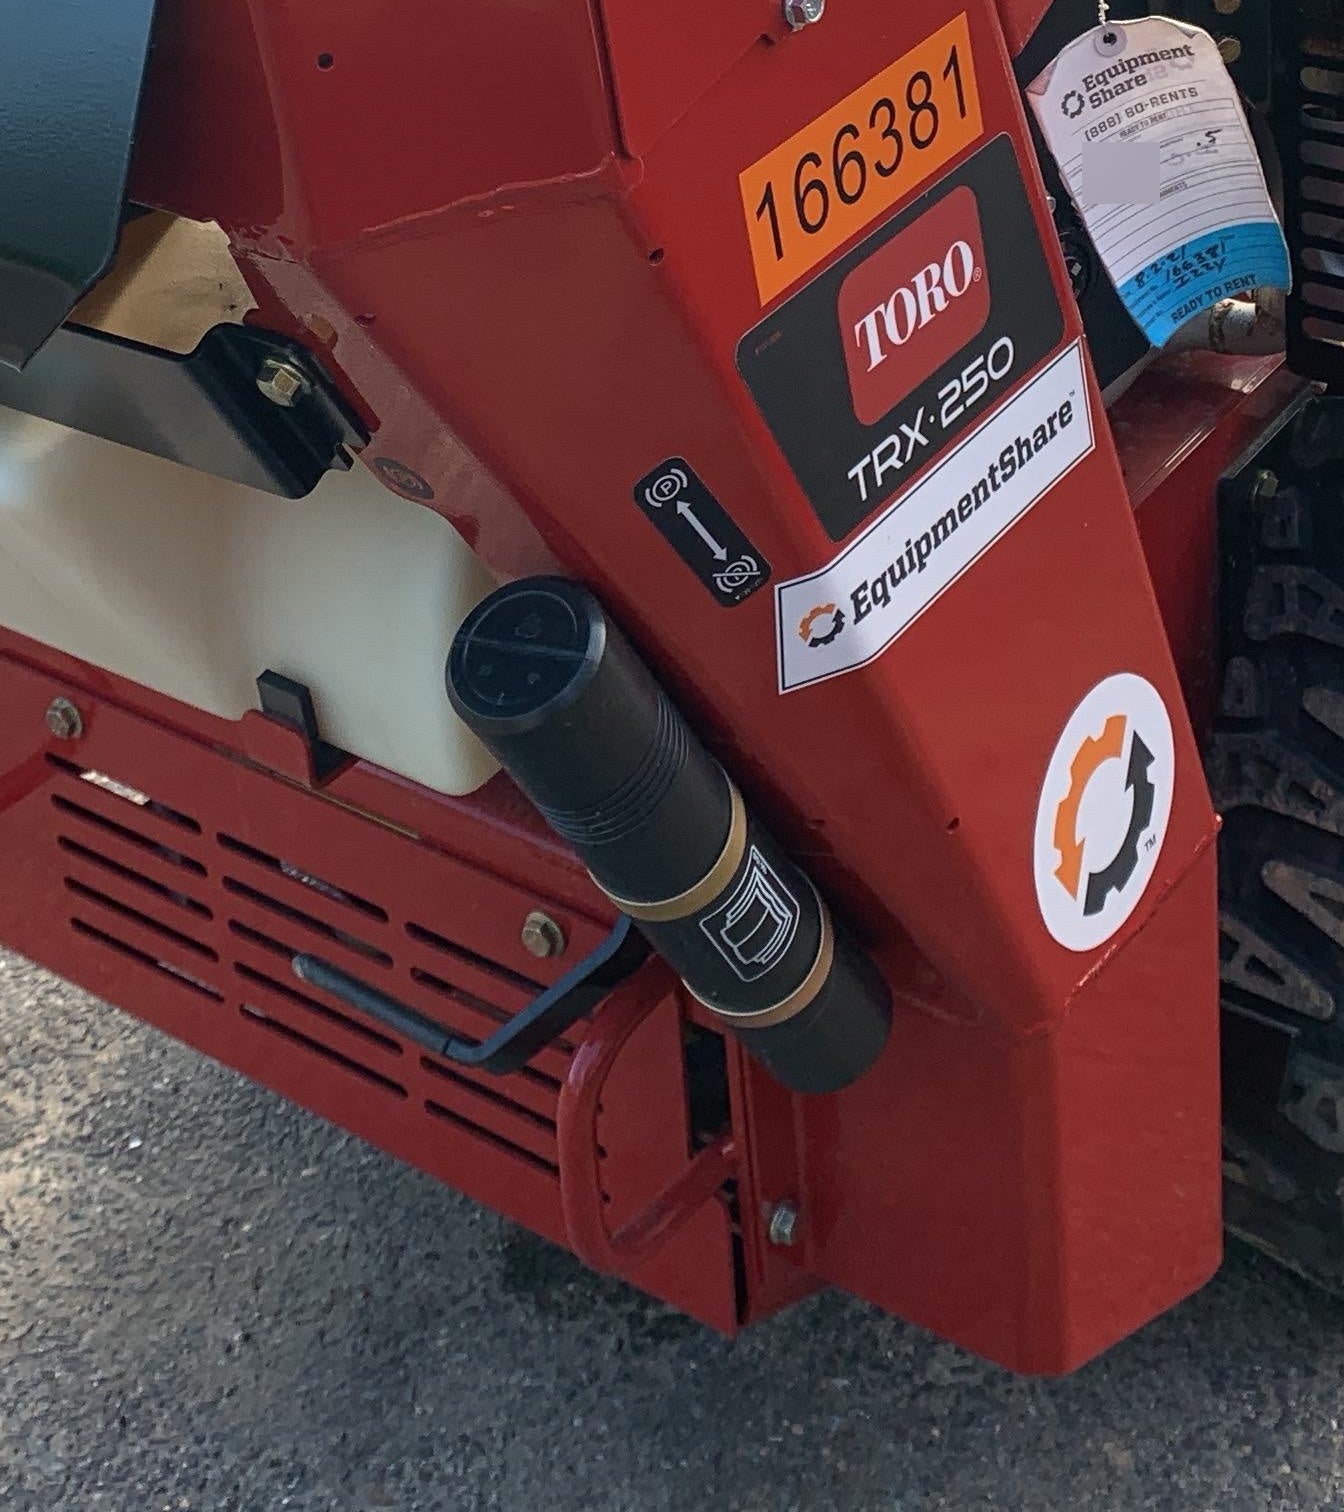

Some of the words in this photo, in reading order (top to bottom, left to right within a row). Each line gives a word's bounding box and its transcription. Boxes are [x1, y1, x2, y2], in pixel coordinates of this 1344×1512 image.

[1082, 44, 1195, 93] Equipment
[1088, 73, 1148, 110] Share
[755, 43, 969, 262] 166381
[1165, 239, 1227, 283] 166381
[854, 240, 975, 373] TORO
[1170, 294, 1204, 324] READY
[1206, 285, 1224, 302] TO
[1224, 273, 1257, 295] RENT
[850, 398, 1074, 626] EquipmentShare
